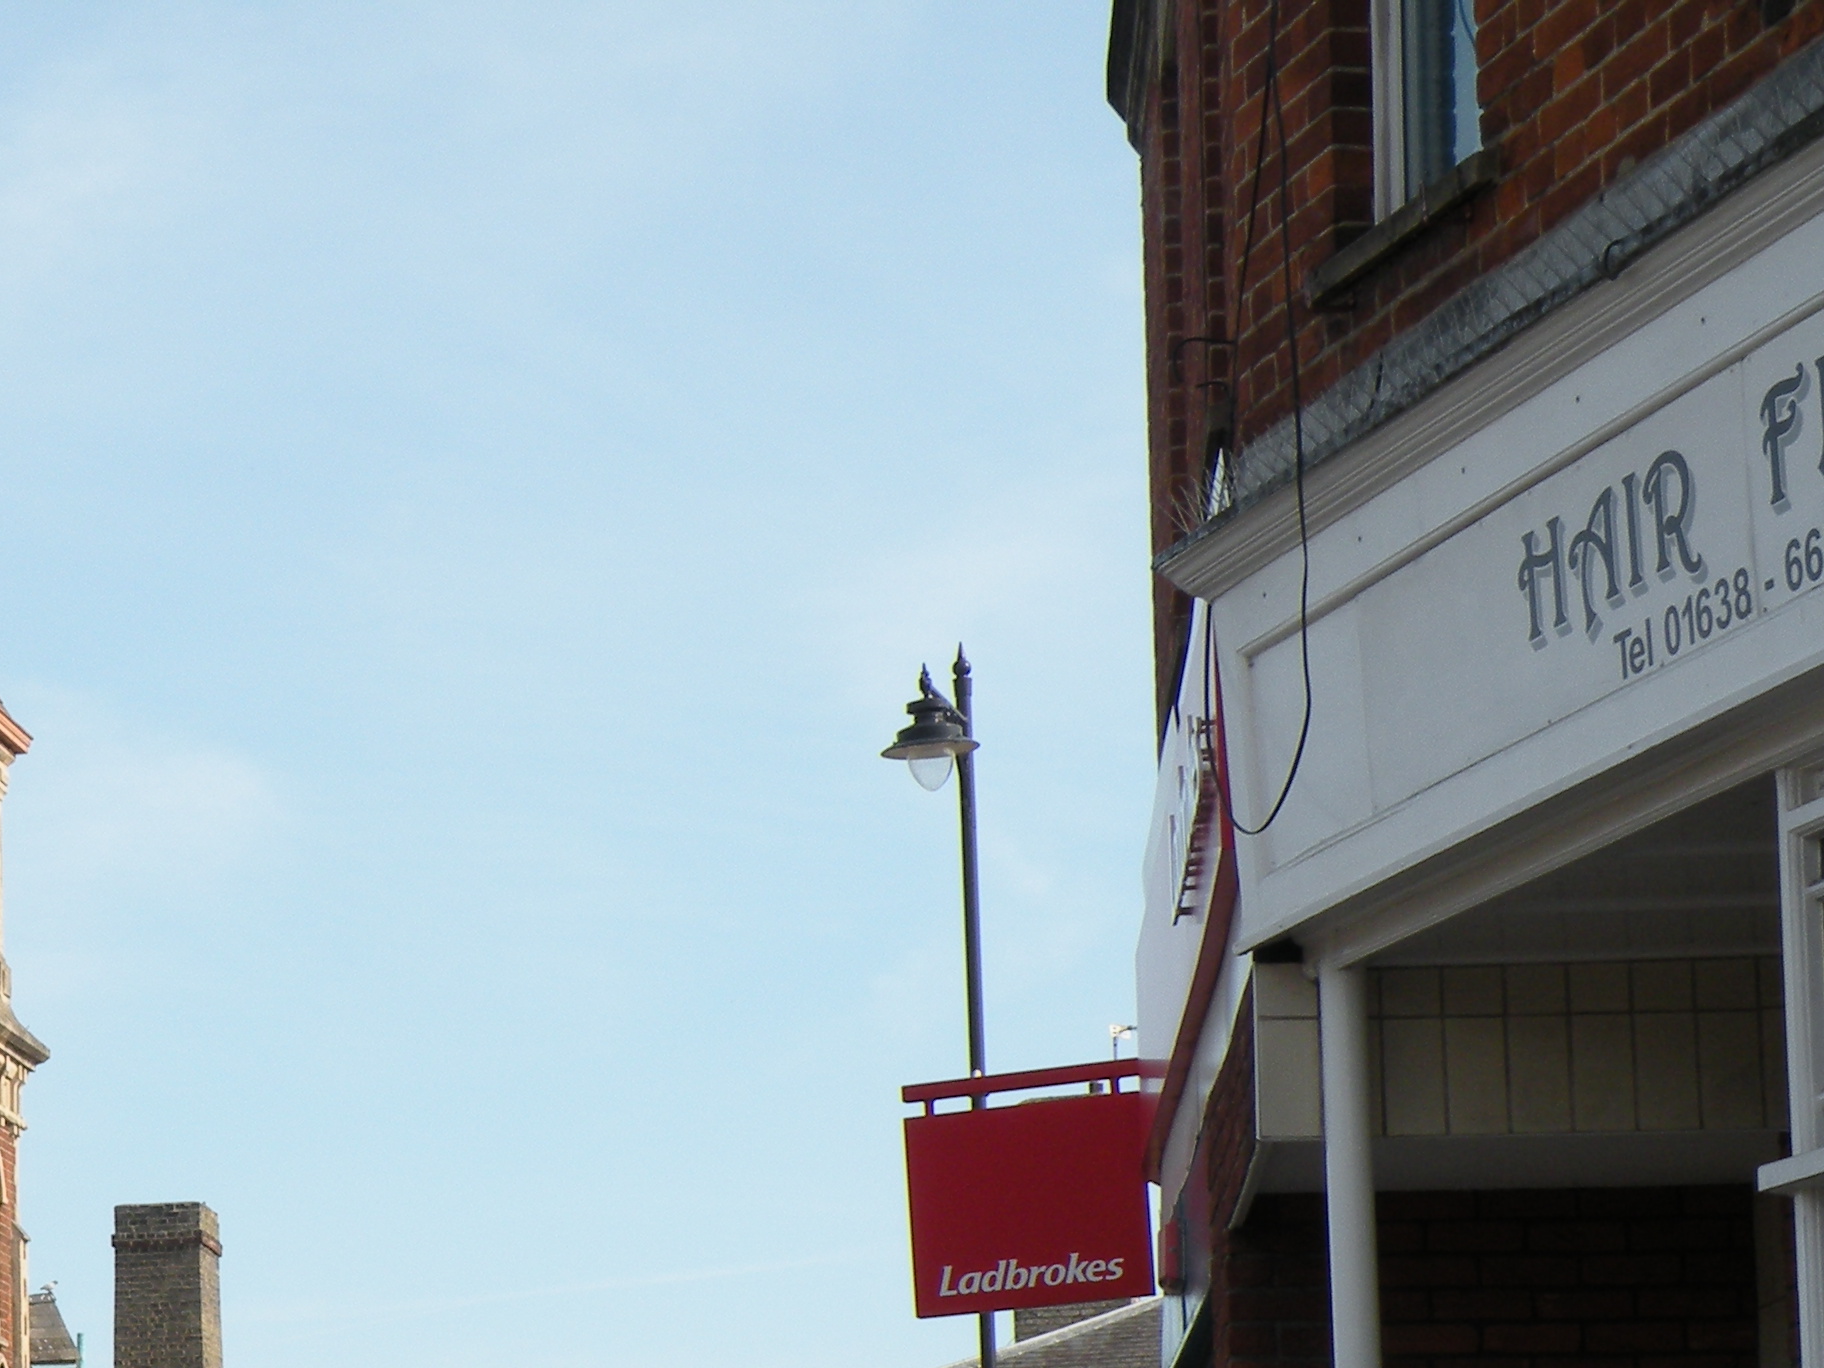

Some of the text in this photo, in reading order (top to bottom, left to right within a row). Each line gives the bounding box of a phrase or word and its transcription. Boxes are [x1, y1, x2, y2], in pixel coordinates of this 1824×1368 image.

[1517, 450, 1706, 648] HAIR
[1613, 617, 1655, 680] Tel
[1663, 567, 1752, 655] 01638
[939, 1252, 1125, 1298] Ladbrokes
